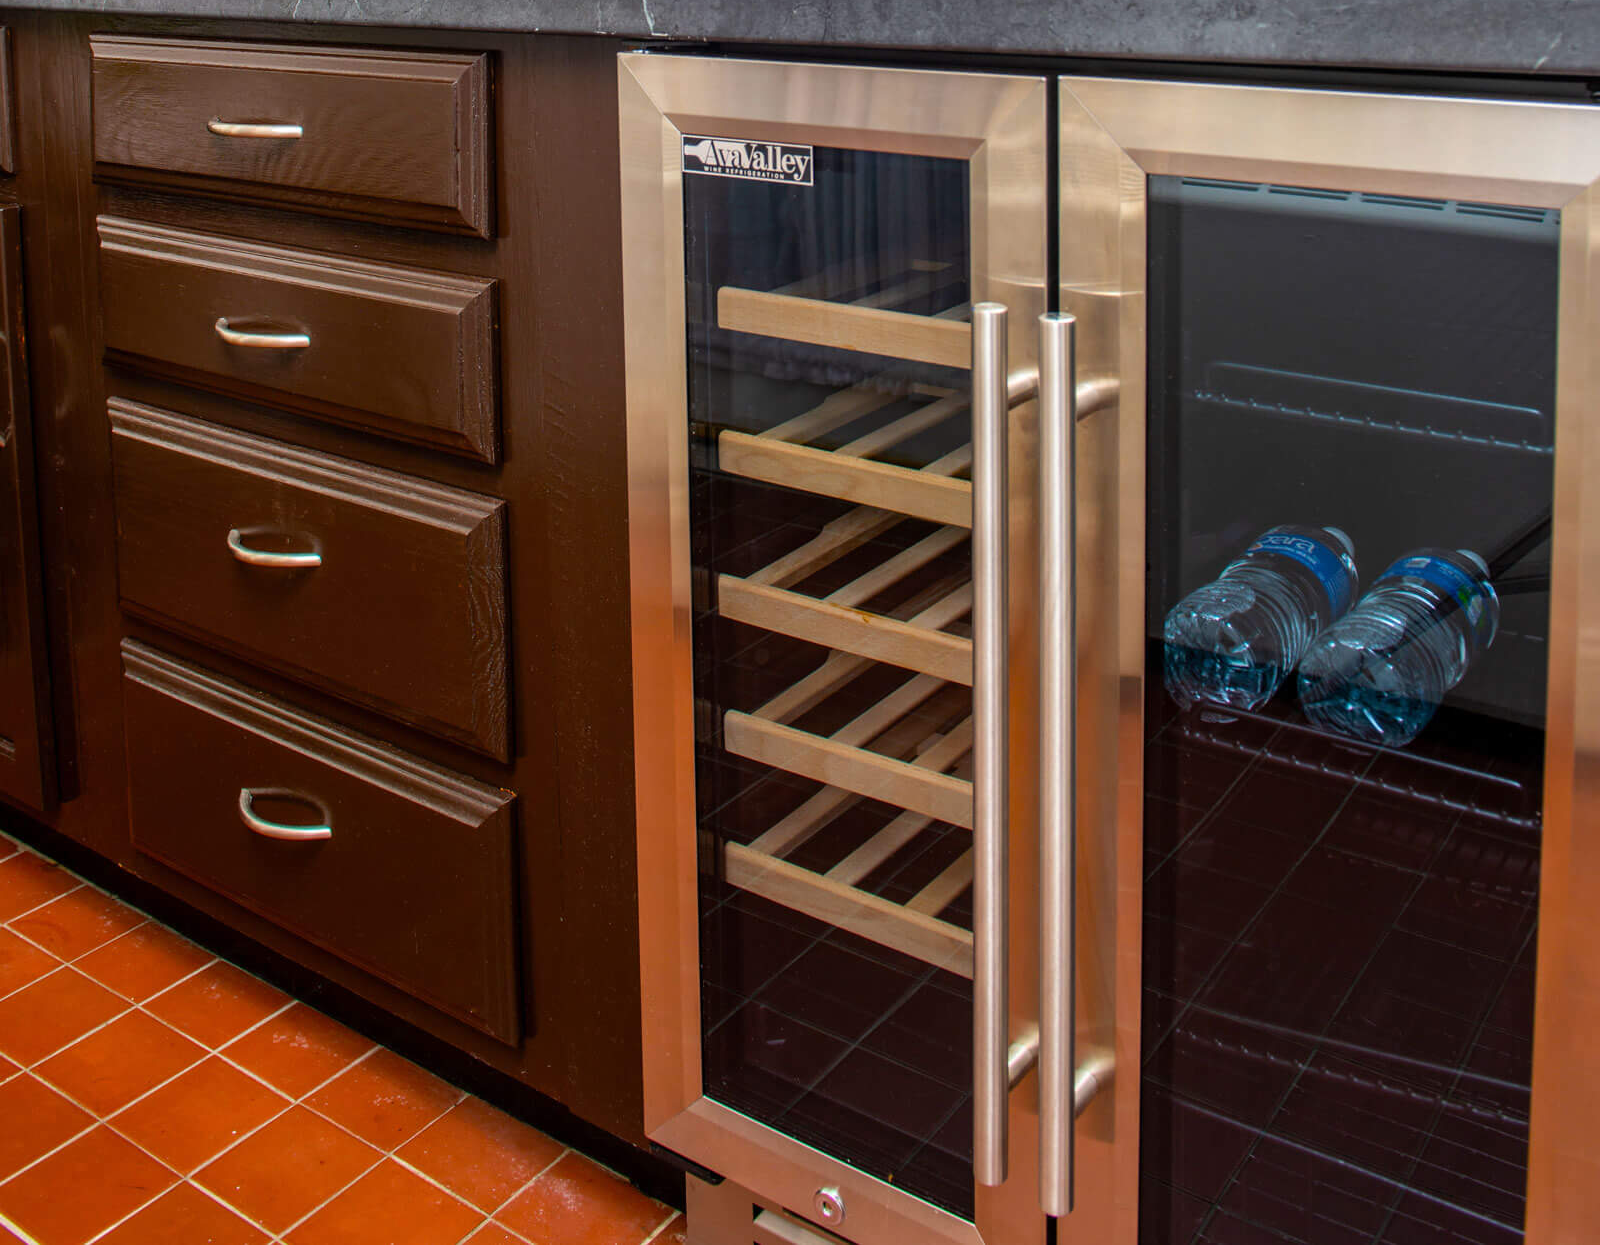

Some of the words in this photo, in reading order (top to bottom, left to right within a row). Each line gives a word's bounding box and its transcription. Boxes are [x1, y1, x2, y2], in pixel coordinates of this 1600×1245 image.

[703, 139, 810, 181] AvaValley
[703, 165, 722, 173] WINE
[725, 167, 785, 180] REFRIGERATION
